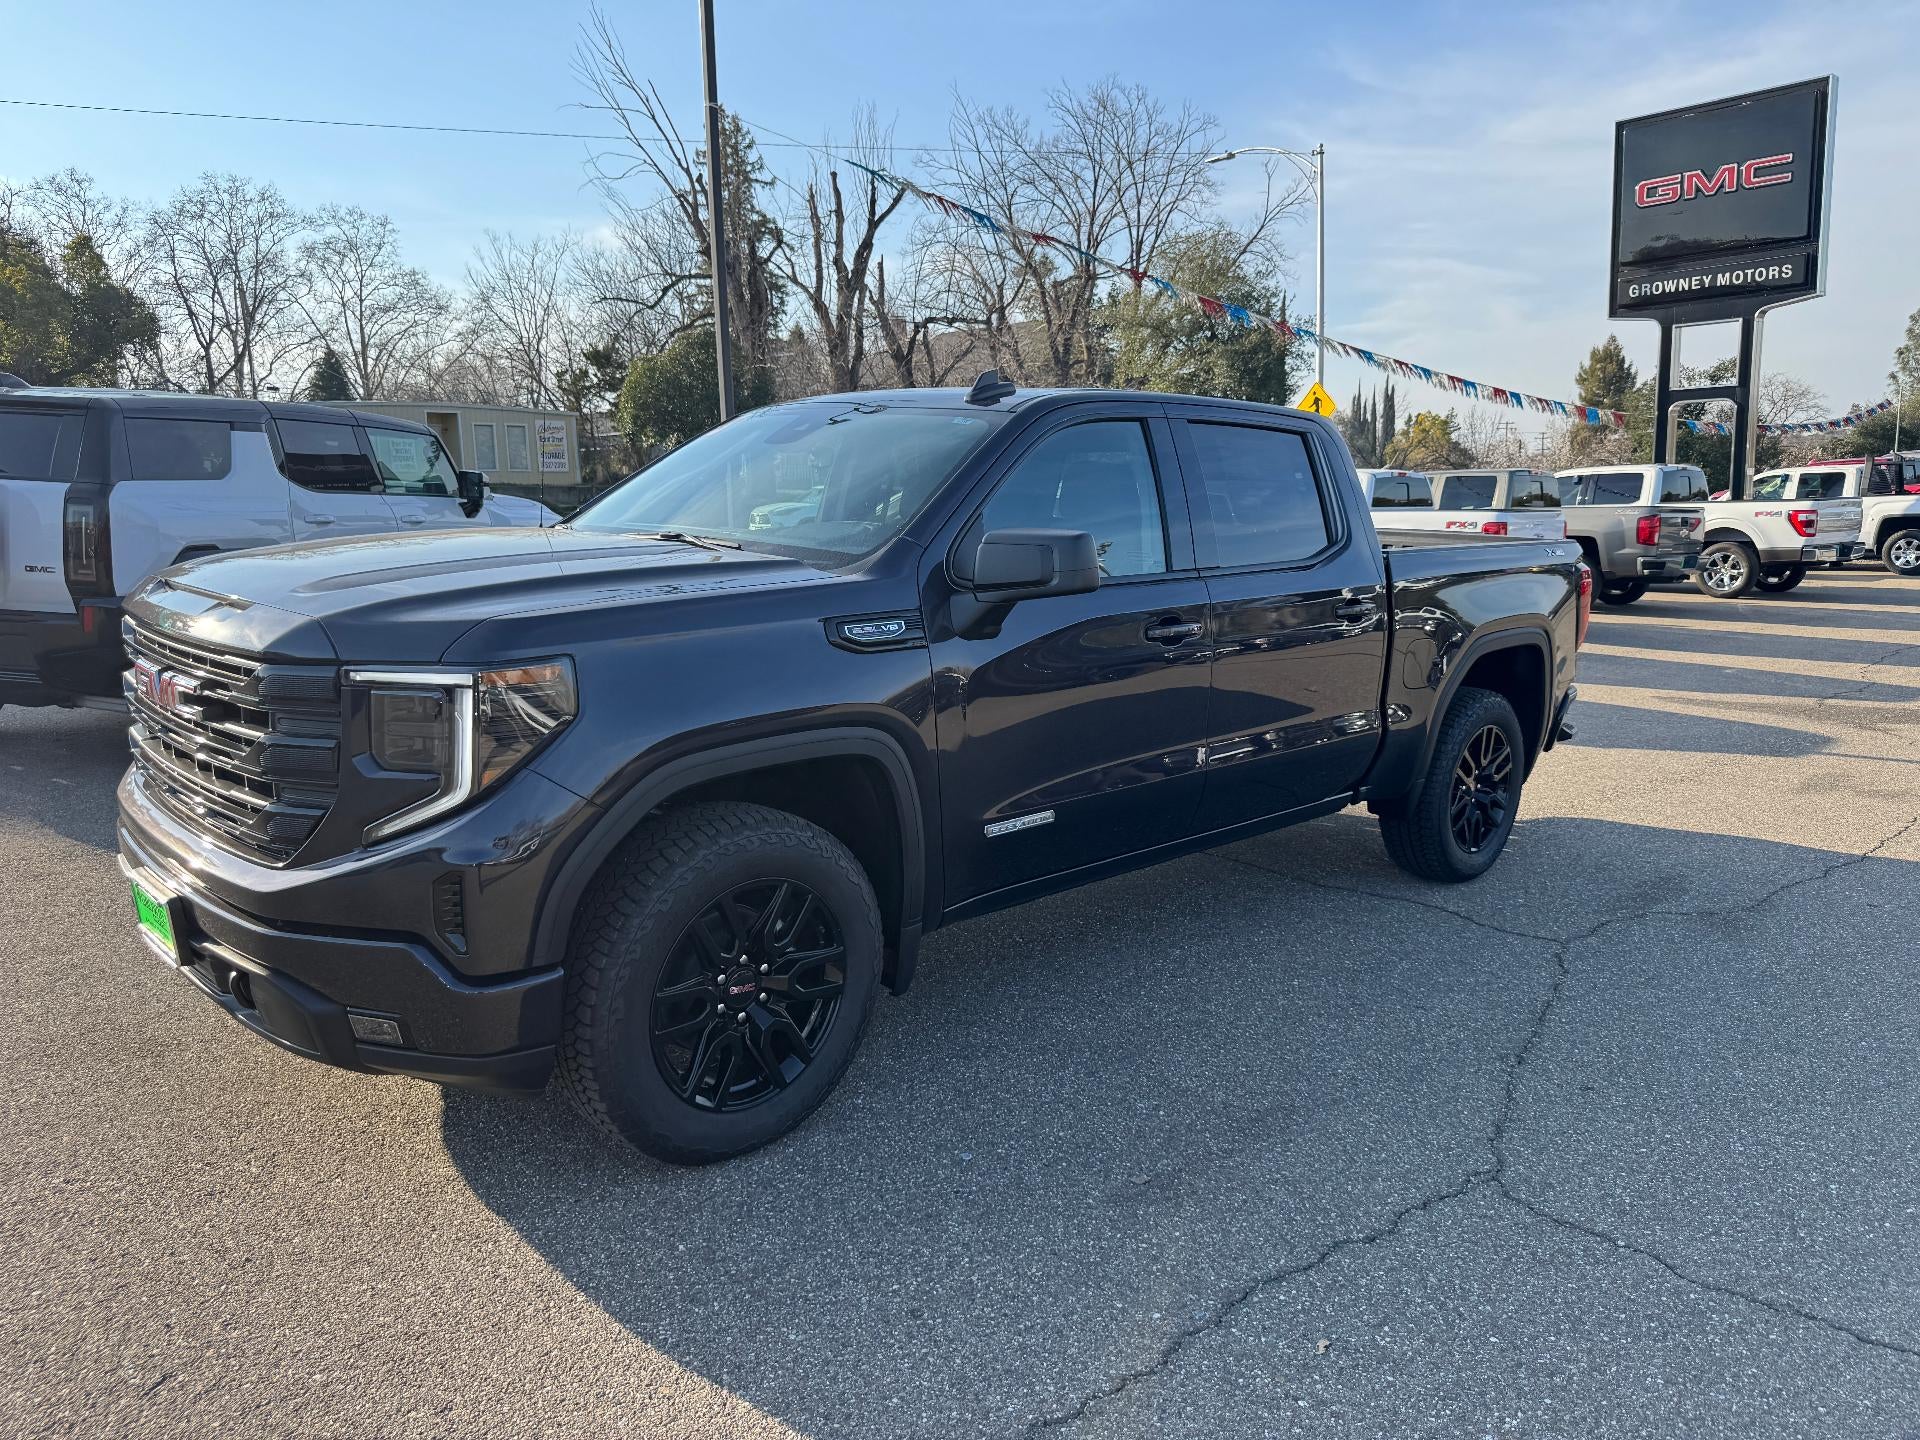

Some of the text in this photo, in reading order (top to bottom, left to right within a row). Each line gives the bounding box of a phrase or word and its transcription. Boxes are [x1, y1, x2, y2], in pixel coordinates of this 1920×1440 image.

[1635, 153, 1793, 207] GMC
[1628, 264, 1793, 298] GROWNEY MOTORS
[1446, 521, 1477, 529] FX4
[24, 565, 56, 573] GMC
[134, 658, 203, 720] GMC
[729, 982, 756, 995] GMC
